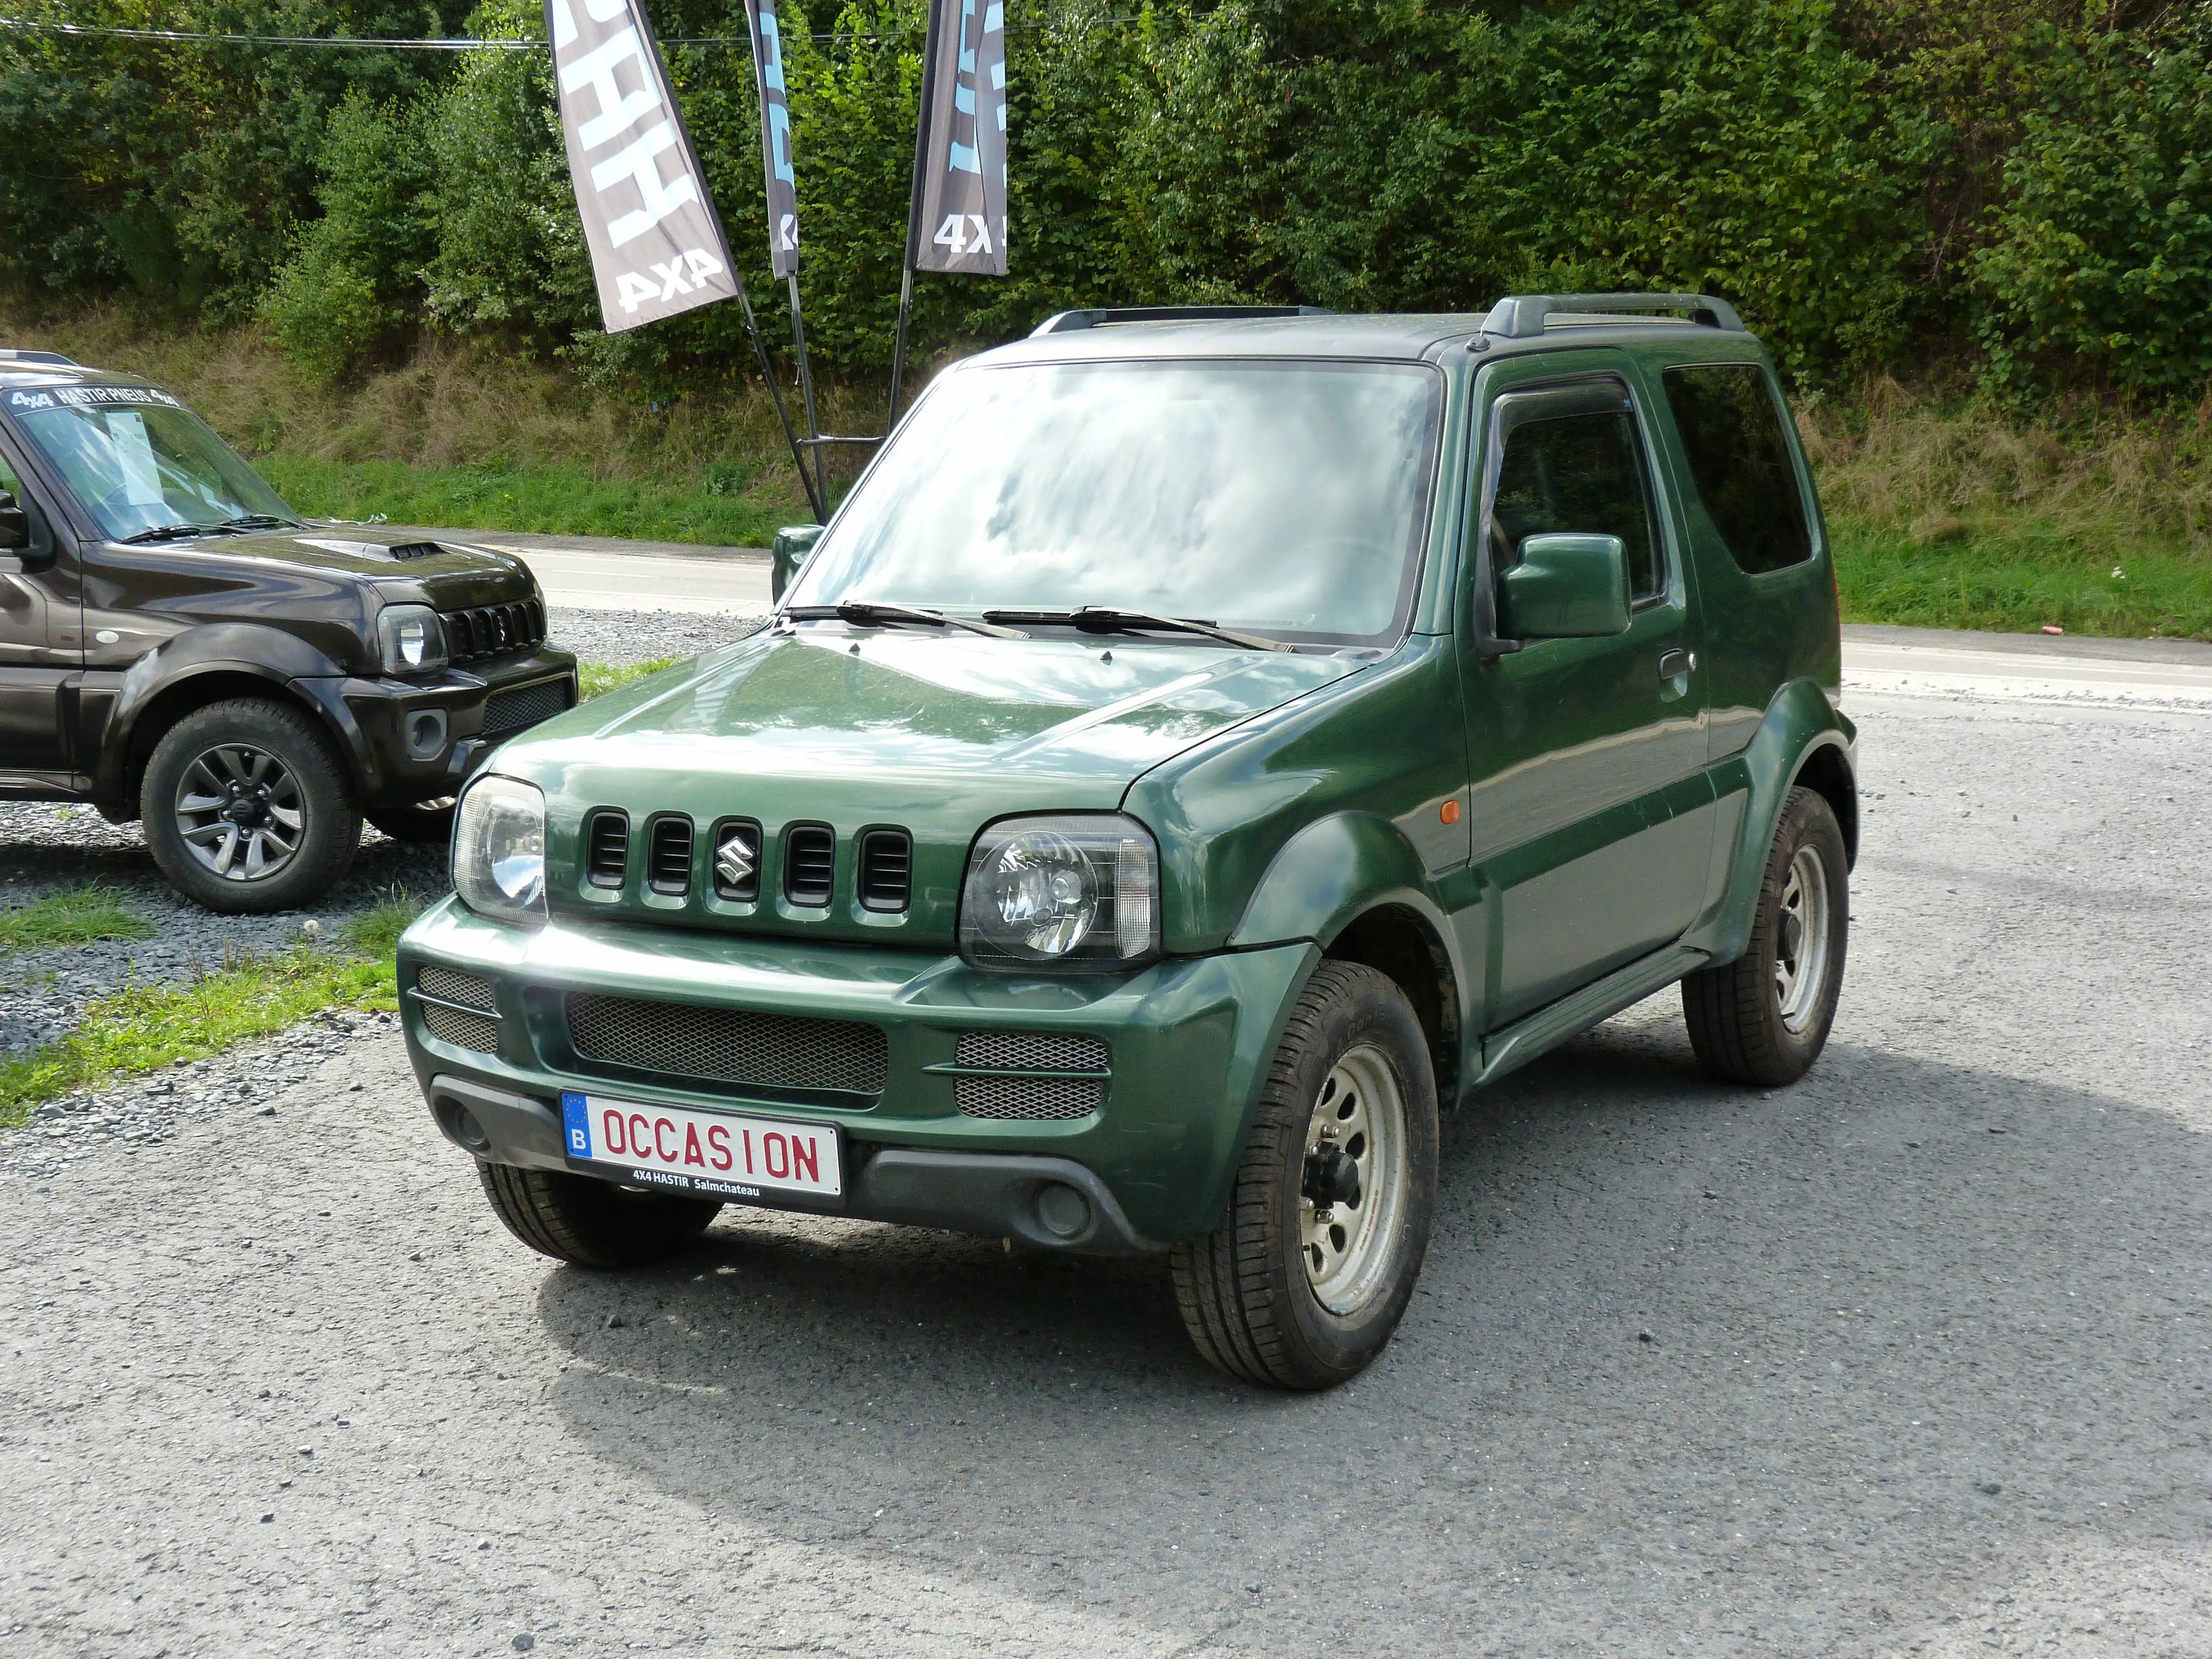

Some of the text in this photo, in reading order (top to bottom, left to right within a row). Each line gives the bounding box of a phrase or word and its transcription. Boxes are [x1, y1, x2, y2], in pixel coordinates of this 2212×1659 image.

[933, 214, 1007, 253] 4X
[55, 388, 109, 404] HASTIR
[109, 387, 153, 403] PNEUS
[572, 1128, 586, 1150] B
[603, 1109, 820, 1183] OCCASION
[632, 1170, 760, 1198] 4X4 HASTIR Salmchateau
